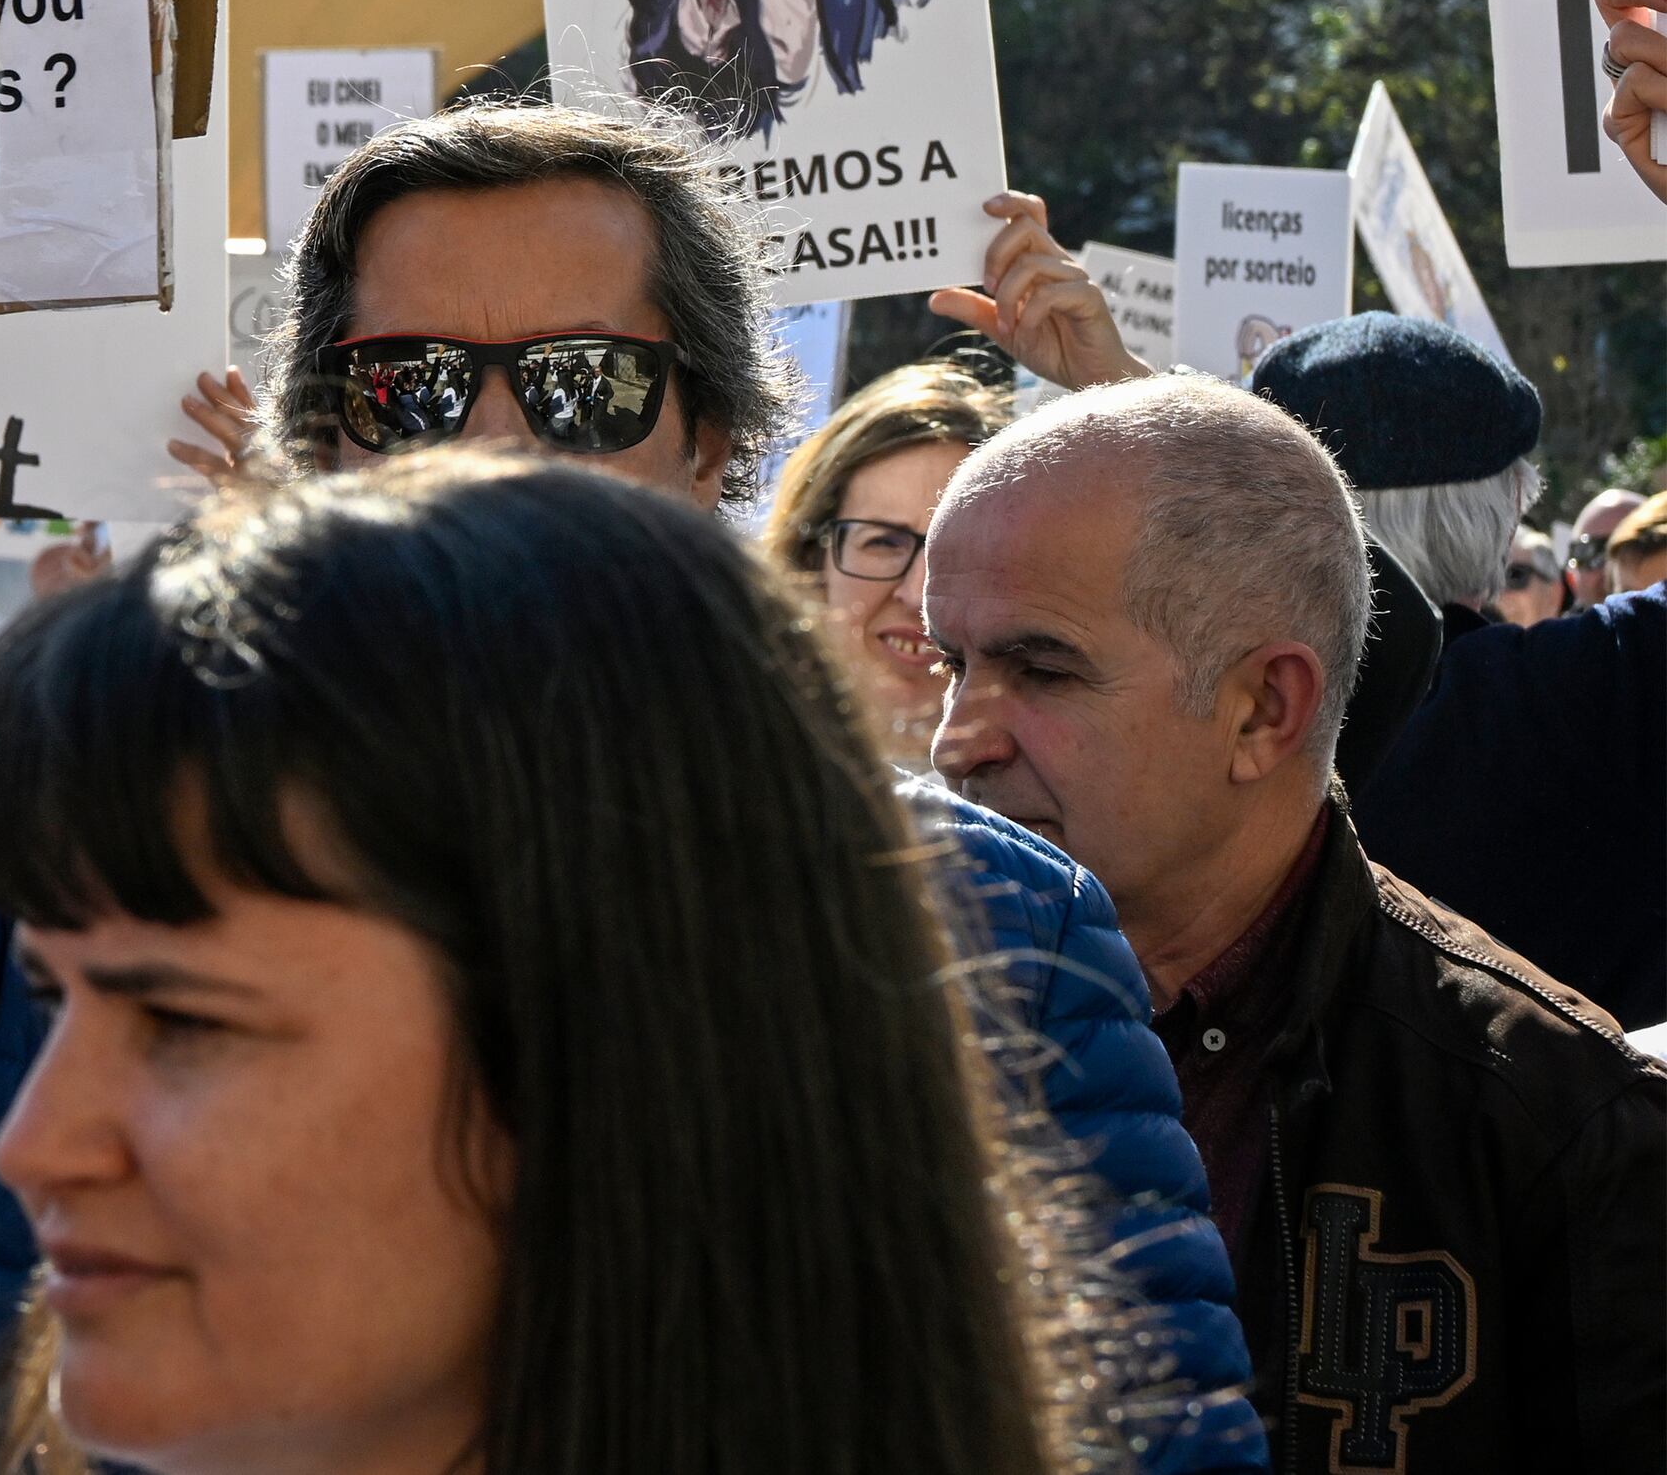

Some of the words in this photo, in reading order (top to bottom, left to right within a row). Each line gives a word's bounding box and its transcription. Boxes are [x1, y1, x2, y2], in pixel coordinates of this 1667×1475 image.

[43, 52, 77, 109] ?
[920, 140, 958, 182] A
[1221, 200, 1303, 241] licenças
[1205, 256, 1239, 287] por
[1244, 254, 1317, 287] sorteio
